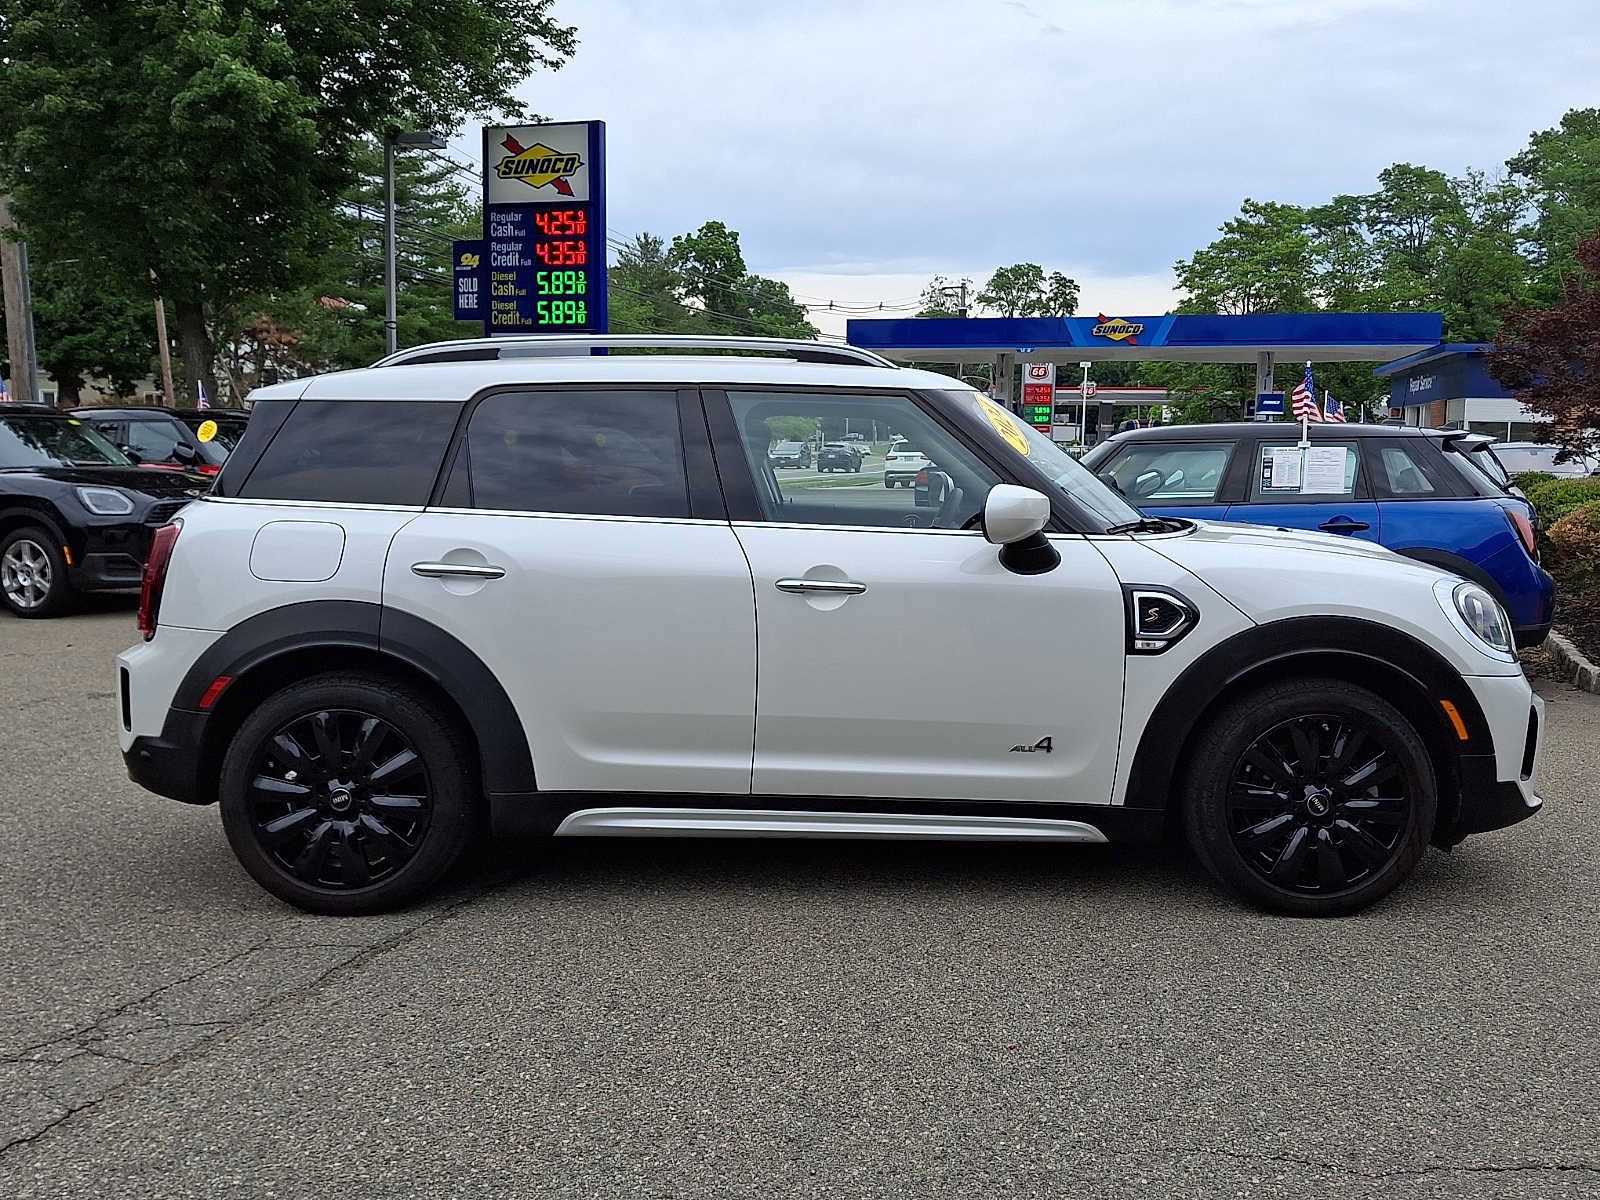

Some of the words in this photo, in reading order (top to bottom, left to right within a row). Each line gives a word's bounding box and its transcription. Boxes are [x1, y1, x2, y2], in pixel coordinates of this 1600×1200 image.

[501, 157, 577, 176] SUNOCO
[490, 212, 522, 223] Regular
[536, 211, 575, 234] 4.25
[490, 223, 514, 237] Cash
[490, 242, 522, 253] Regular
[536, 241, 575, 264] 4.35
[491, 252, 520, 267] Credit
[520, 258, 532, 266] Full
[491, 272, 517, 281] Diesel
[537, 271, 575, 294] 5.89
[458, 278, 478, 292] SOLD
[491, 281, 515, 296] Cash
[458, 294, 478, 309] HERE
[491, 300, 517, 310] Diesel
[491, 310, 520, 325] Credit
[537, 301, 576, 324] 5.89
[1094, 324, 1141, 335] SUNOCO
[1032, 367, 1046, 376] 66
